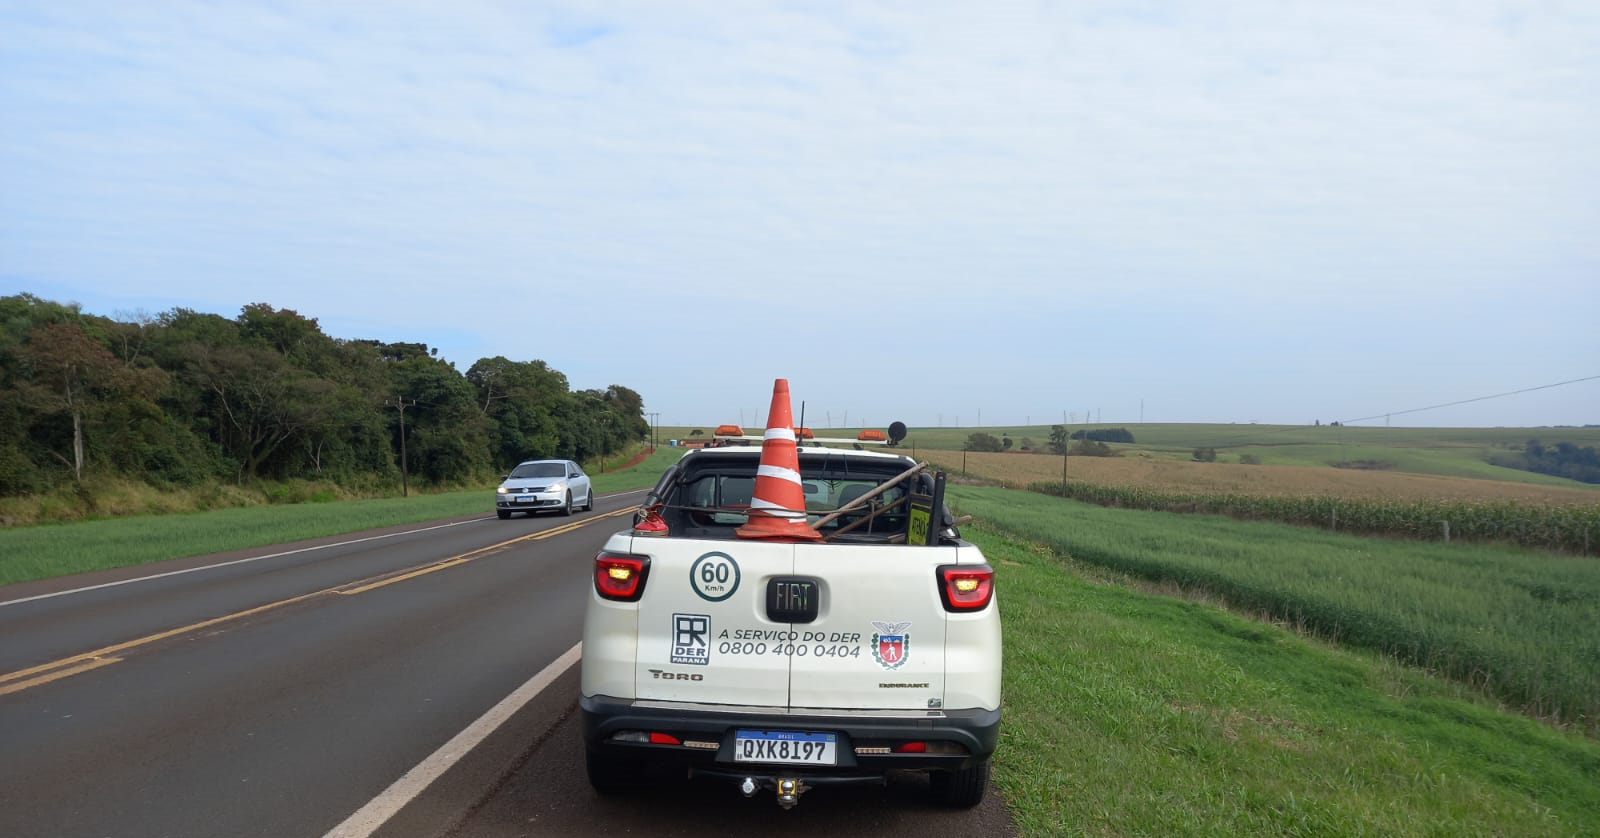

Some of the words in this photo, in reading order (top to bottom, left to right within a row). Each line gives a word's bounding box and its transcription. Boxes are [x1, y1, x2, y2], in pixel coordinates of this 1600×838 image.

[701, 562, 729, 584] 60
[705, 584, 724, 592] Km/h
[776, 583, 811, 611] FIAT
[718, 629, 729, 639] A
[734, 629, 798, 643] SERVIÇO
[802, 632, 826, 642] DO
[829, 633, 861, 643] DER
[675, 647, 706, 657] DER
[719, 642, 767, 655] 0800
[772, 644, 807, 656] 400
[813, 645, 861, 658] 0404
[648, 669, 704, 681] TORO
